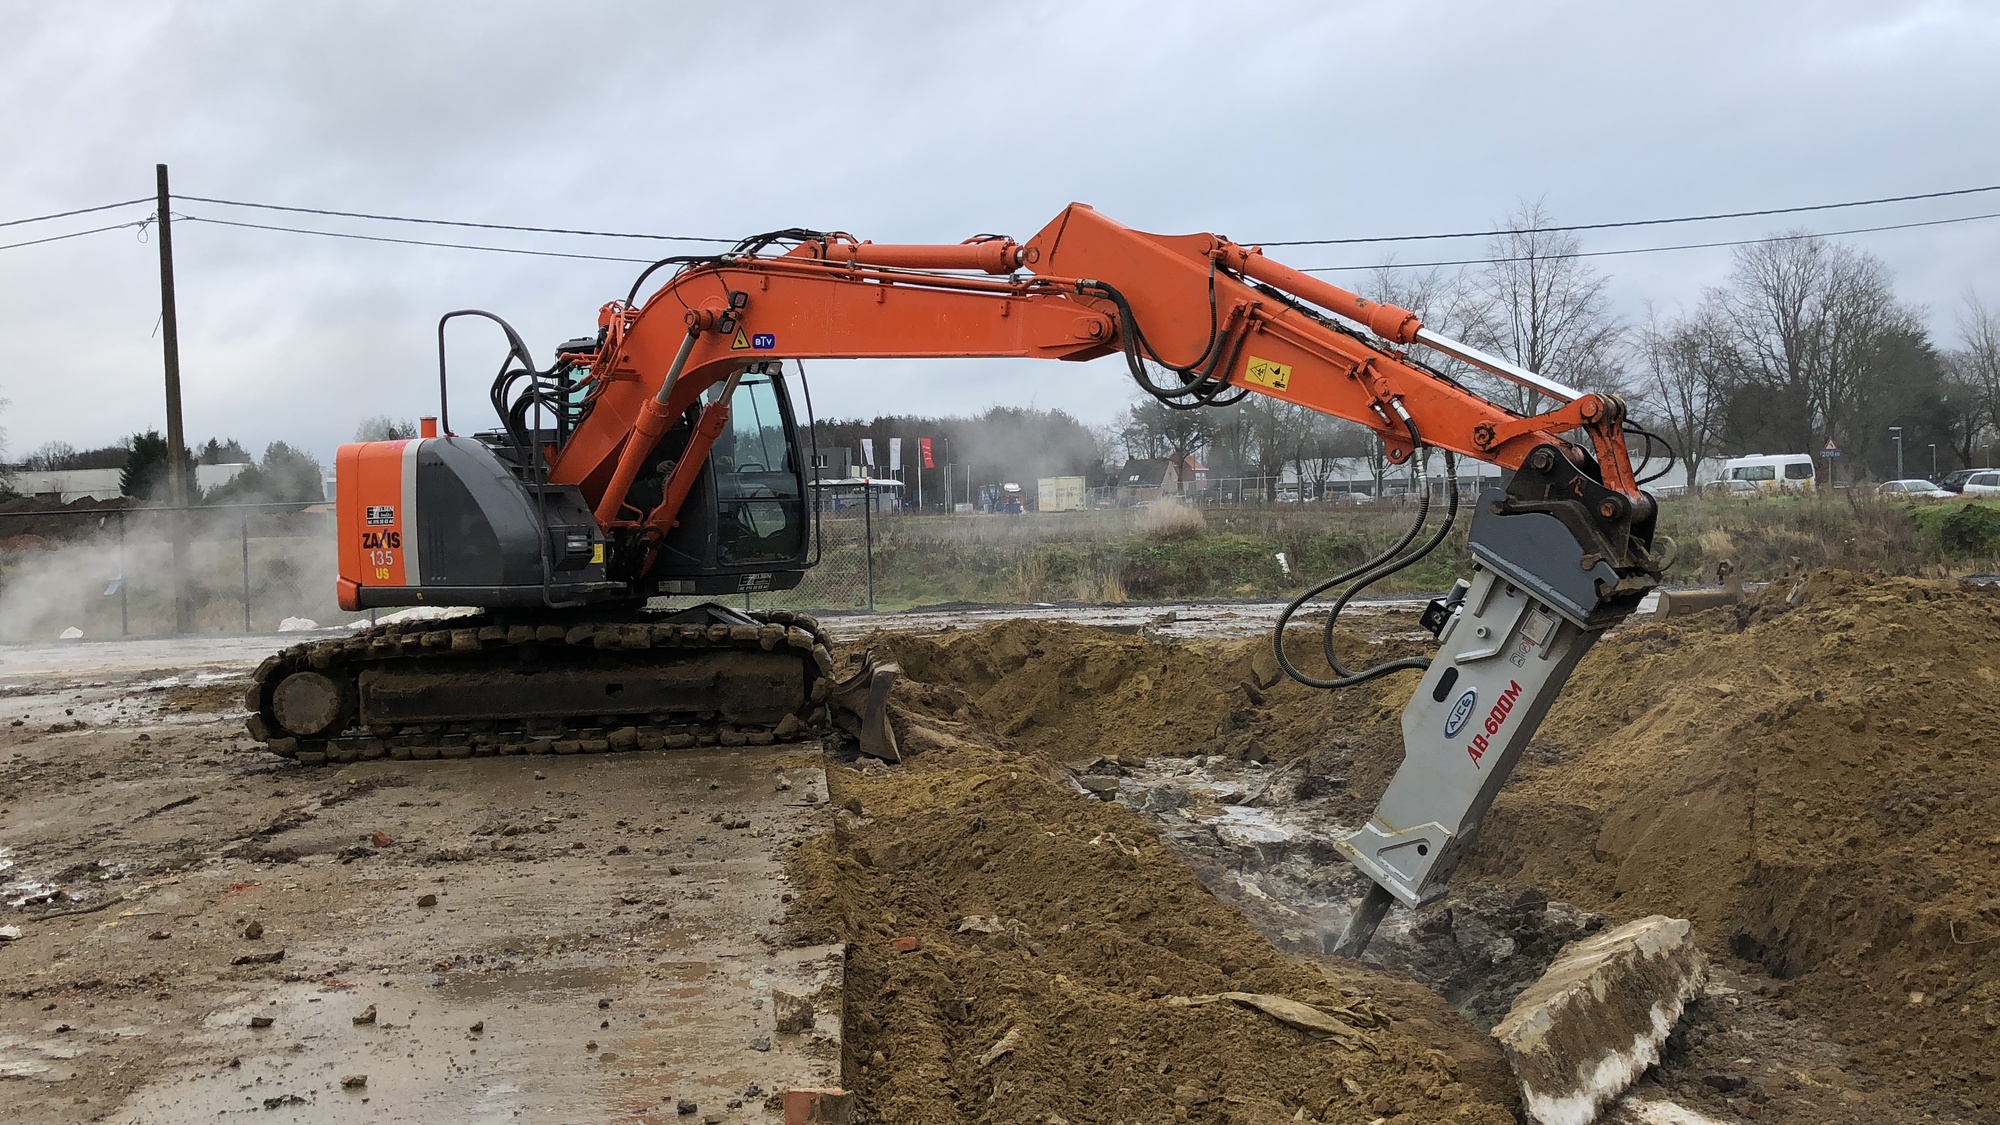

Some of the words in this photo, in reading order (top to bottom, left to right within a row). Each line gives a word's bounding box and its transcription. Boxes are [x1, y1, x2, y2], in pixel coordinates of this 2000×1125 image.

[755, 336, 772, 347] BTV
[362, 529, 401, 549] ZAXIS
[370, 550, 393, 566] 135
[376, 568, 390, 580] US
[1450, 698, 1472, 730] AJCE
[1467, 680, 1523, 770] AB-600M
